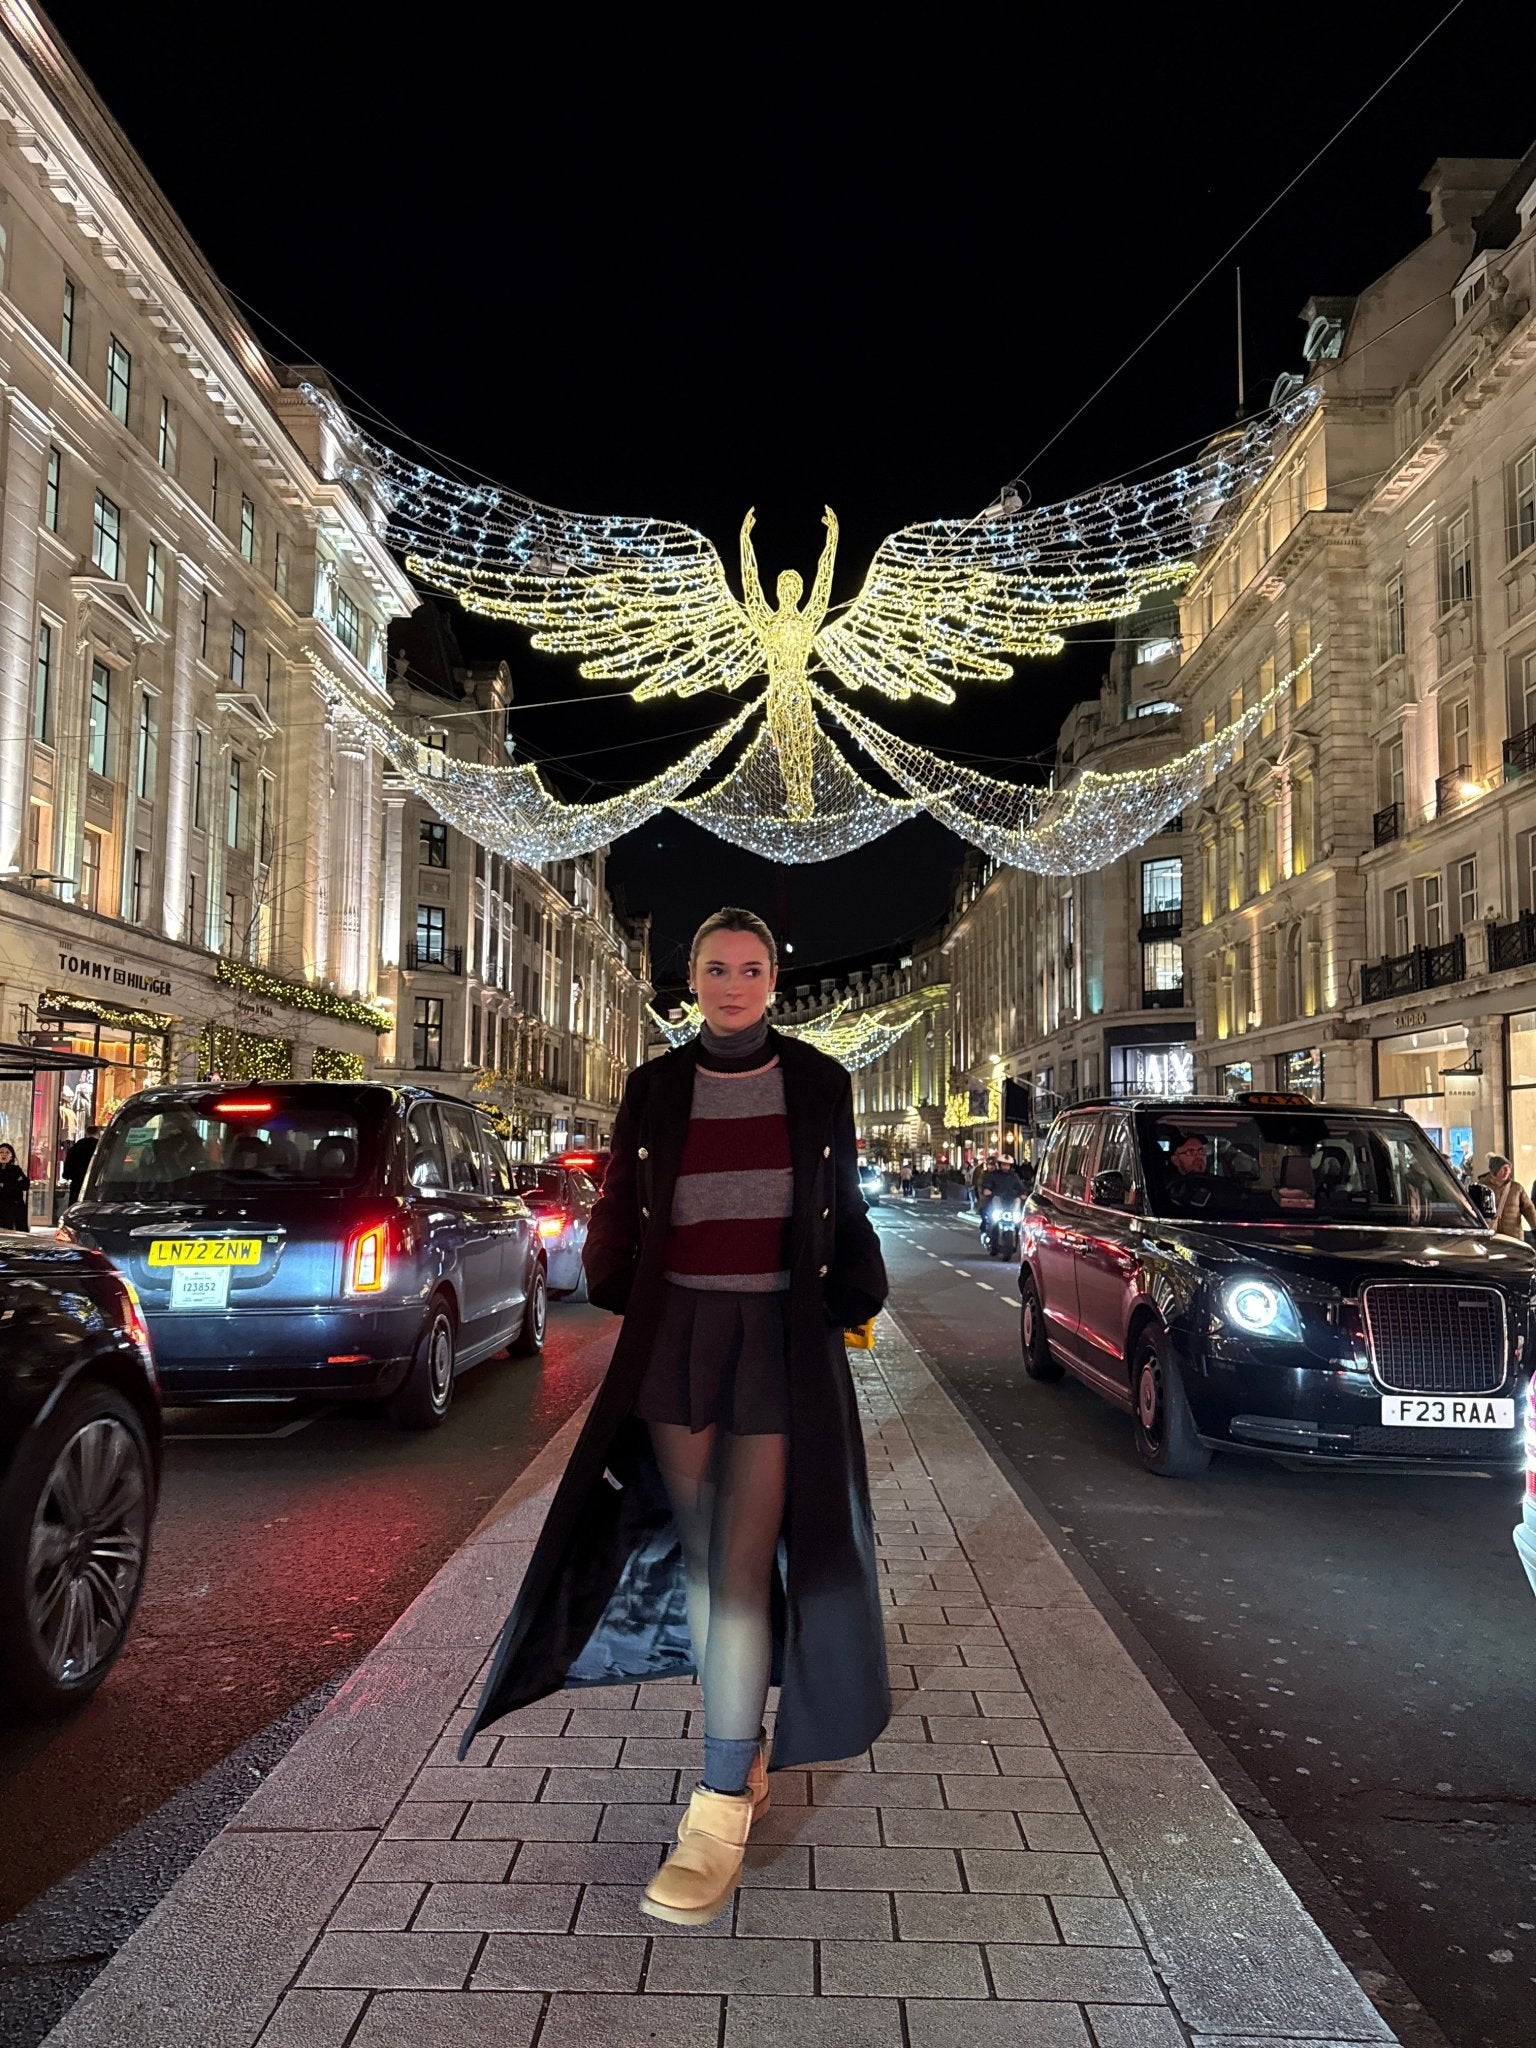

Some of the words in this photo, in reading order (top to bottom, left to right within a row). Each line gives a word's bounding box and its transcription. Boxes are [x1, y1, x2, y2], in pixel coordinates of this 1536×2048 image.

[59, 954, 111, 980] TOMMY
[127, 972, 172, 996] HILFIGER
[1393, 1012, 1427, 1030] SANDRO
[156, 1243, 206, 1260] LN72
[213, 1243, 252, 1260] ZNW
[183, 1282, 216, 1292] 123852
[1400, 1400, 1445, 1422] F23
[1452, 1402, 1496, 1424] RAA
